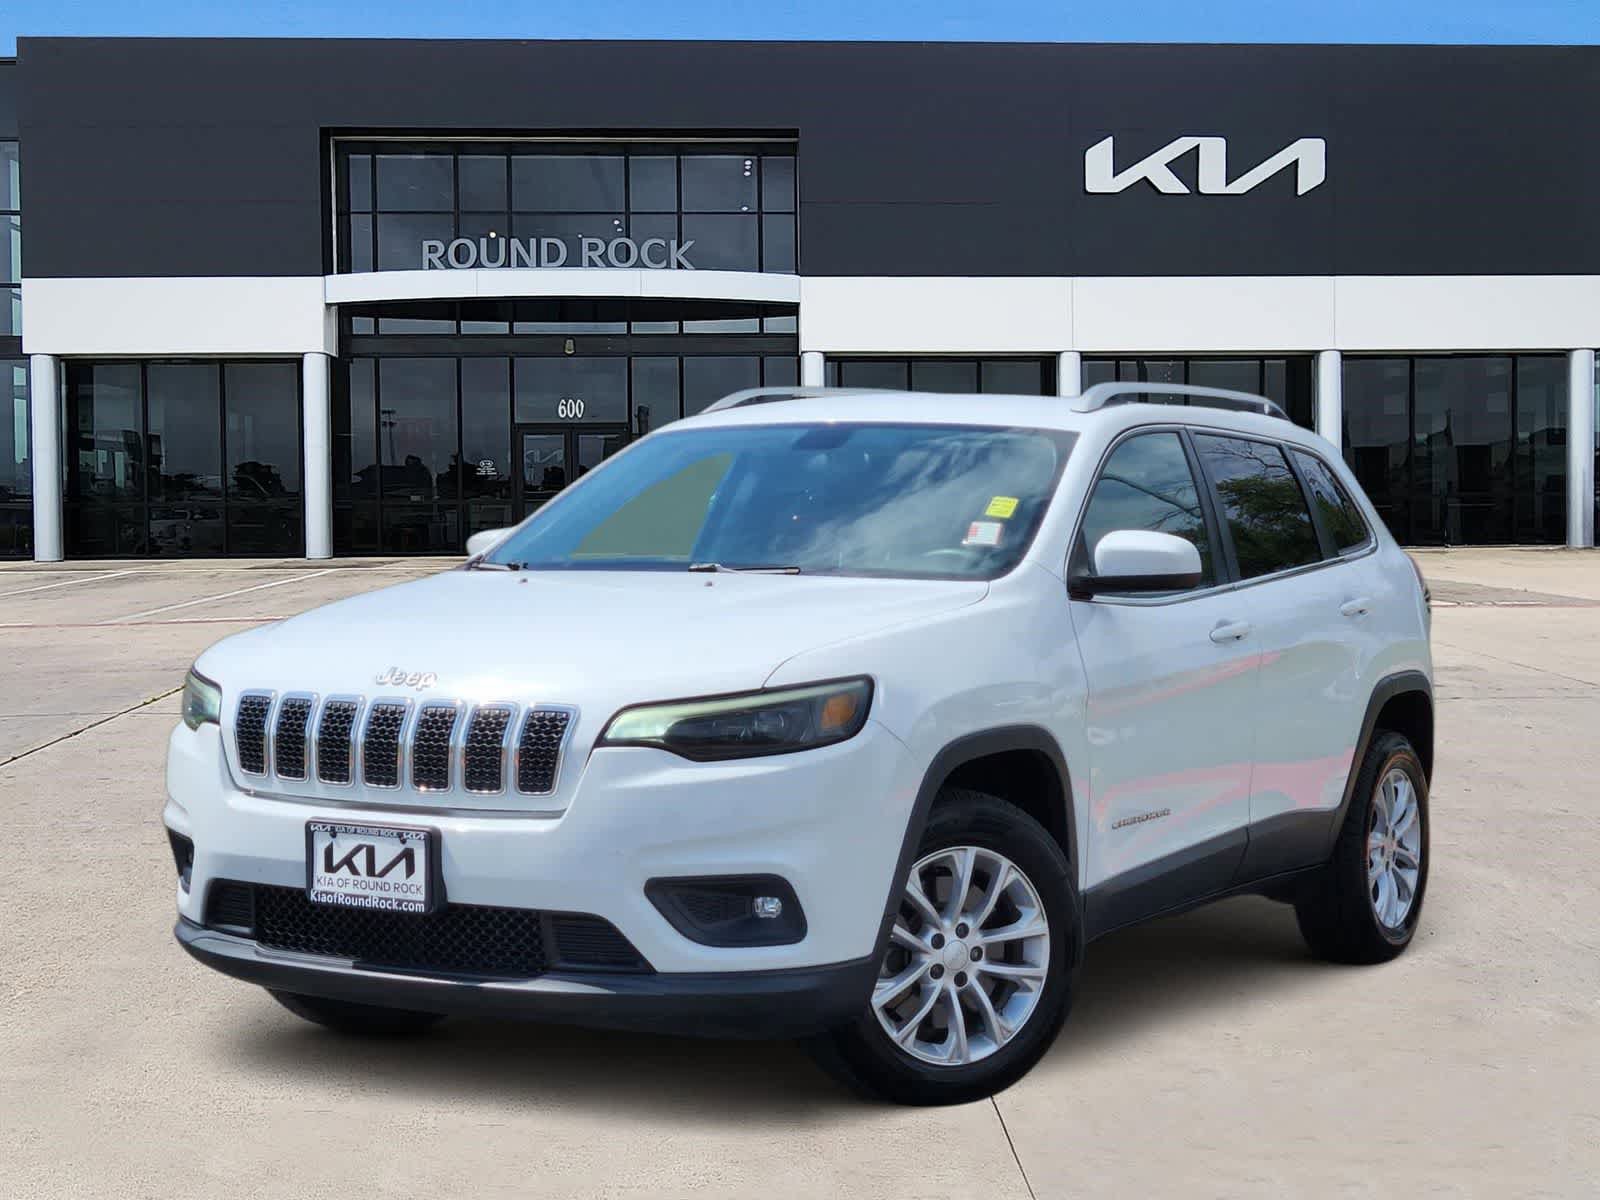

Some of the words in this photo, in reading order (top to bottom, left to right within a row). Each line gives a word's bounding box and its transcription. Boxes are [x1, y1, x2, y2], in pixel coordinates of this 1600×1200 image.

[1085, 135, 1326, 196] KIA
[421, 237, 568, 270] ROUND
[581, 237, 696, 270] ROCK
[558, 399, 584, 418] 600
[376, 666, 438, 691] Jeep
[324, 841, 415, 880] KIA
[316, 876, 334, 886] KIA
[337, 878, 351, 888] OF
[353, 880, 391, 892] ROUND
[394, 884, 423, 895] ROCK
[310, 889, 425, 913] KiaofRoundRock.com
